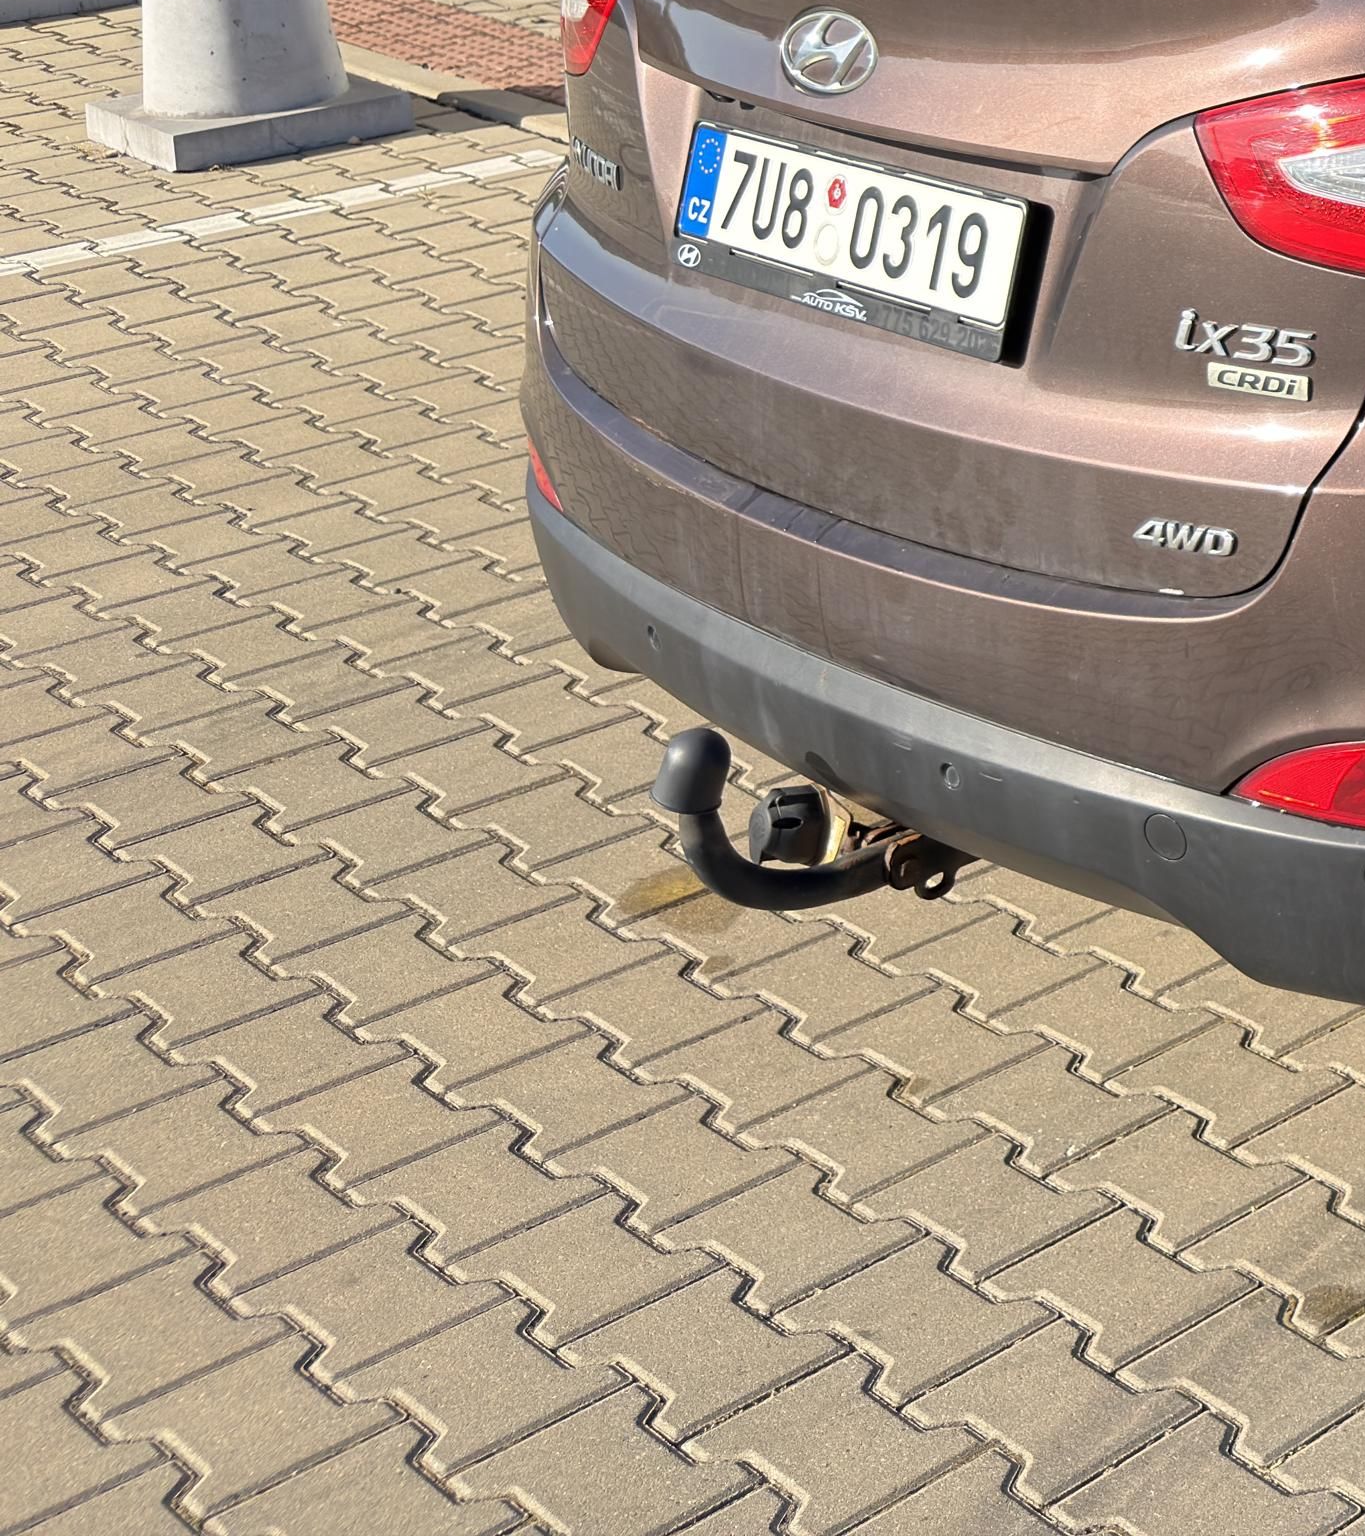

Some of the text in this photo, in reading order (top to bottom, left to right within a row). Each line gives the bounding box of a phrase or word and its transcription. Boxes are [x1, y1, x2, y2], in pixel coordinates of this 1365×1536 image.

[687, 195, 710, 224] CZ
[720, 149, 989, 300] 7U8 0319
[801, 294, 834, 311] AUTO
[1216, 369, 1297, 396] CRDi
[1132, 517, 1239, 557] 4WD
